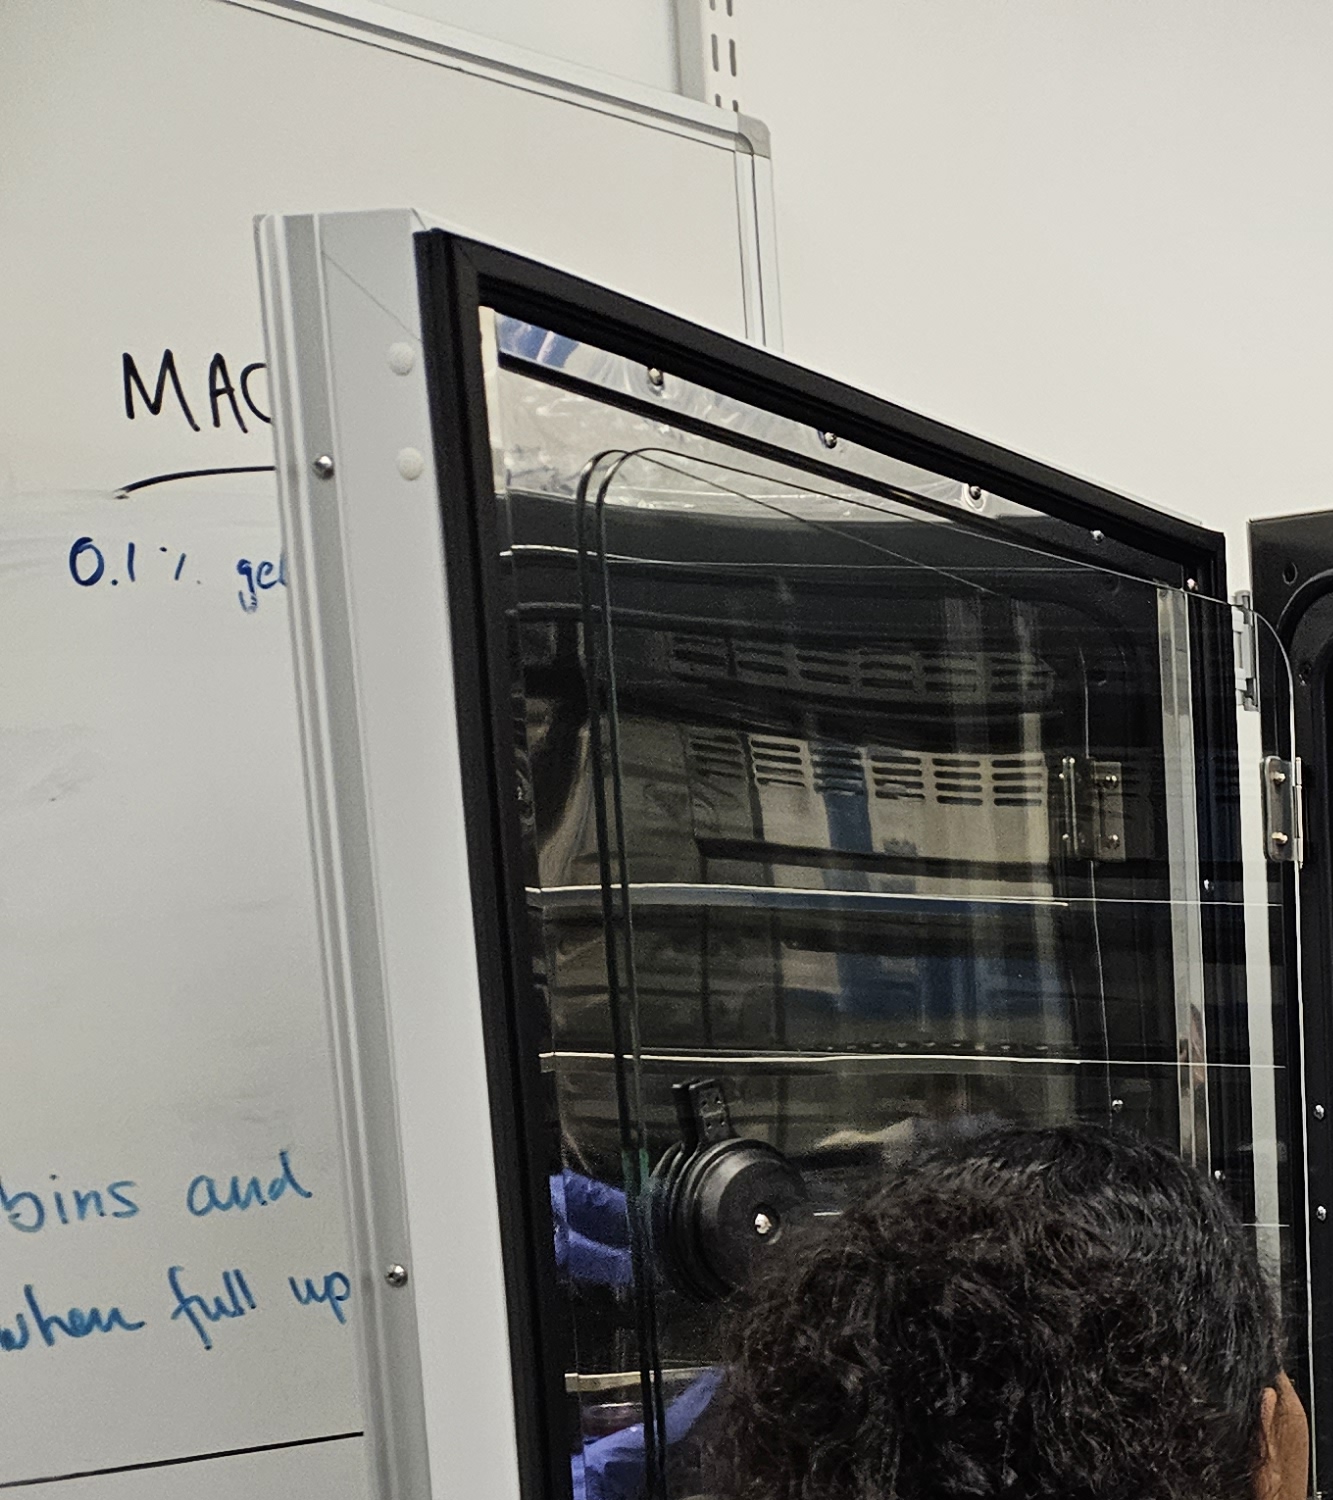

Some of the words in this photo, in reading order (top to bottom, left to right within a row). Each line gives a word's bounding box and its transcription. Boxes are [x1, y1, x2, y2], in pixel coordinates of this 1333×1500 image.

[187, 1149, 313, 1217] and
[168, 1264, 257, 1351] full
[289, 1269, 351, 1324] up
